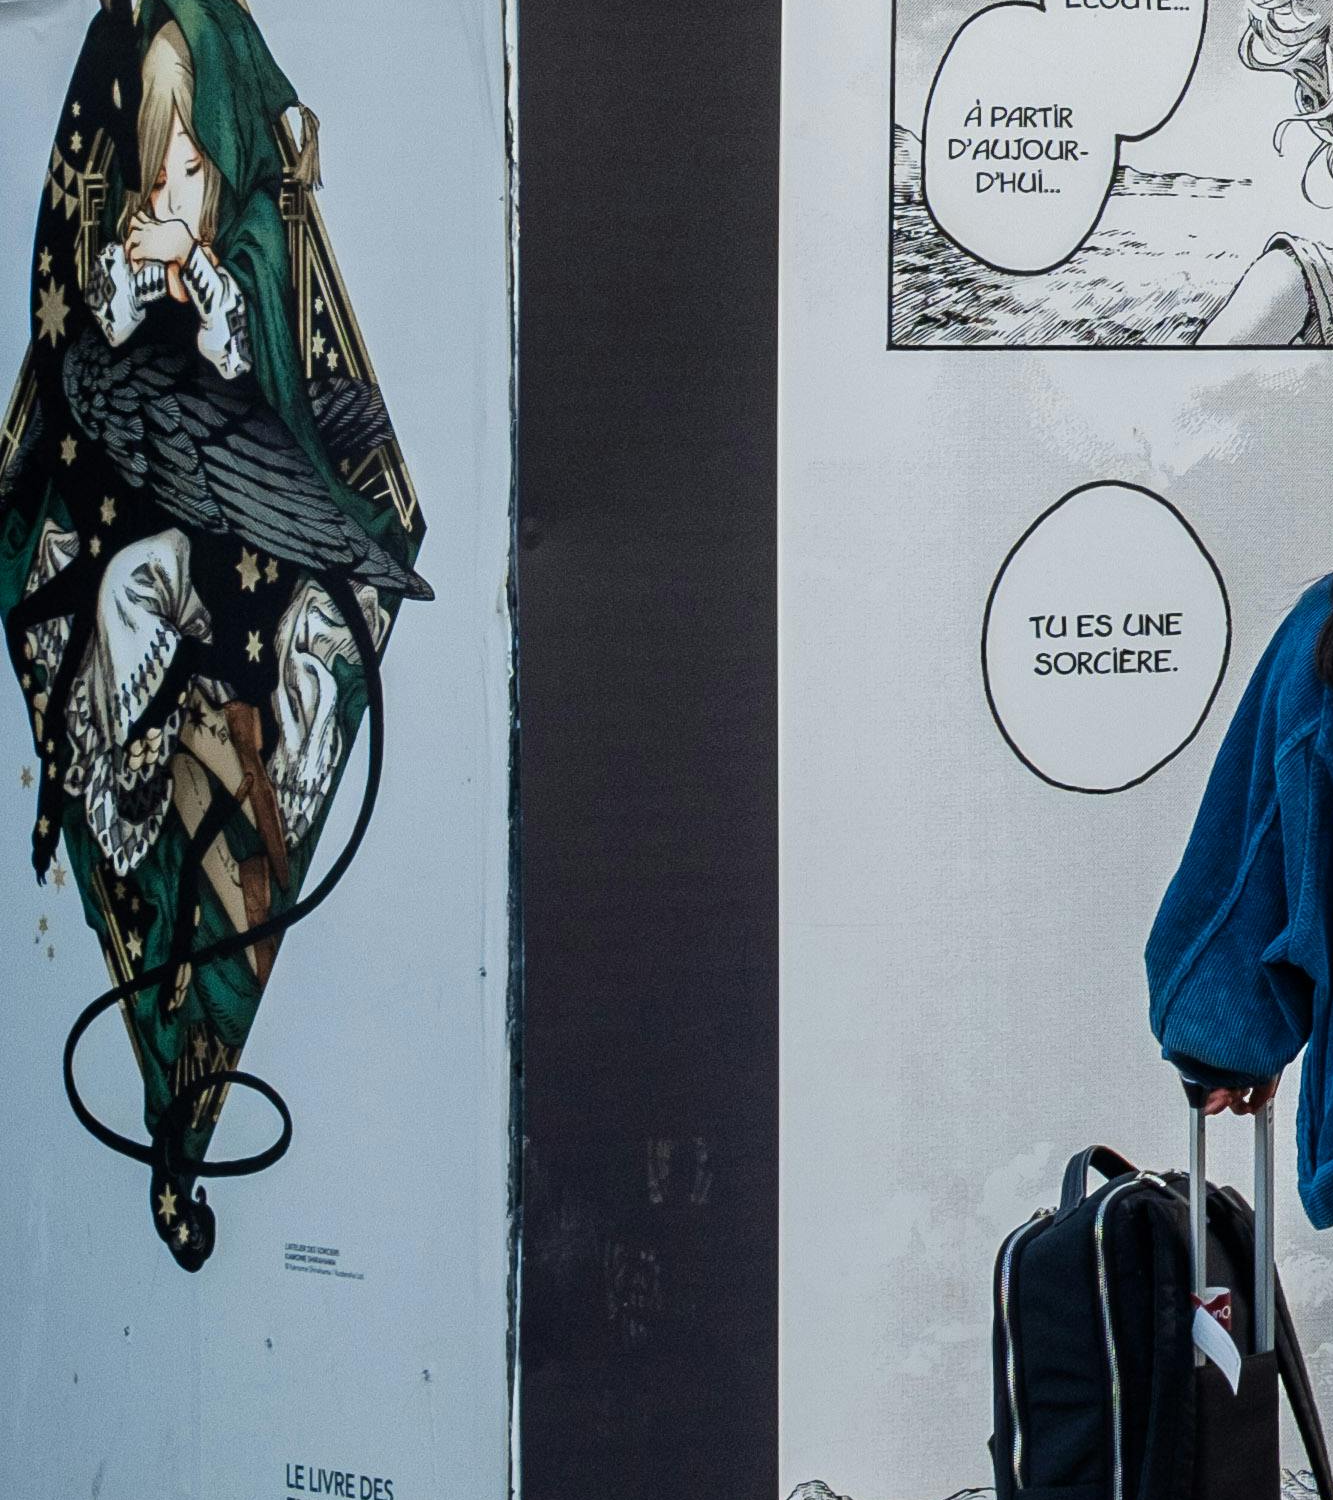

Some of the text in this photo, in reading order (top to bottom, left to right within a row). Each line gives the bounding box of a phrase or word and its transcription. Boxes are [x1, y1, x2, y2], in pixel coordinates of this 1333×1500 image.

[963, 98, 1074, 129] À PARTIR
[947, 137, 1090, 162] D'AUJOUR-
[975, 168, 1061, 194] D'HUI...
[1029, 612, 1184, 639] TU ES UNE
[1033, 646, 1178, 676] SORCIÈRE.
[286, 1462, 305, 1490] LE
[309, 1466, 356, 1500] LIVRE
